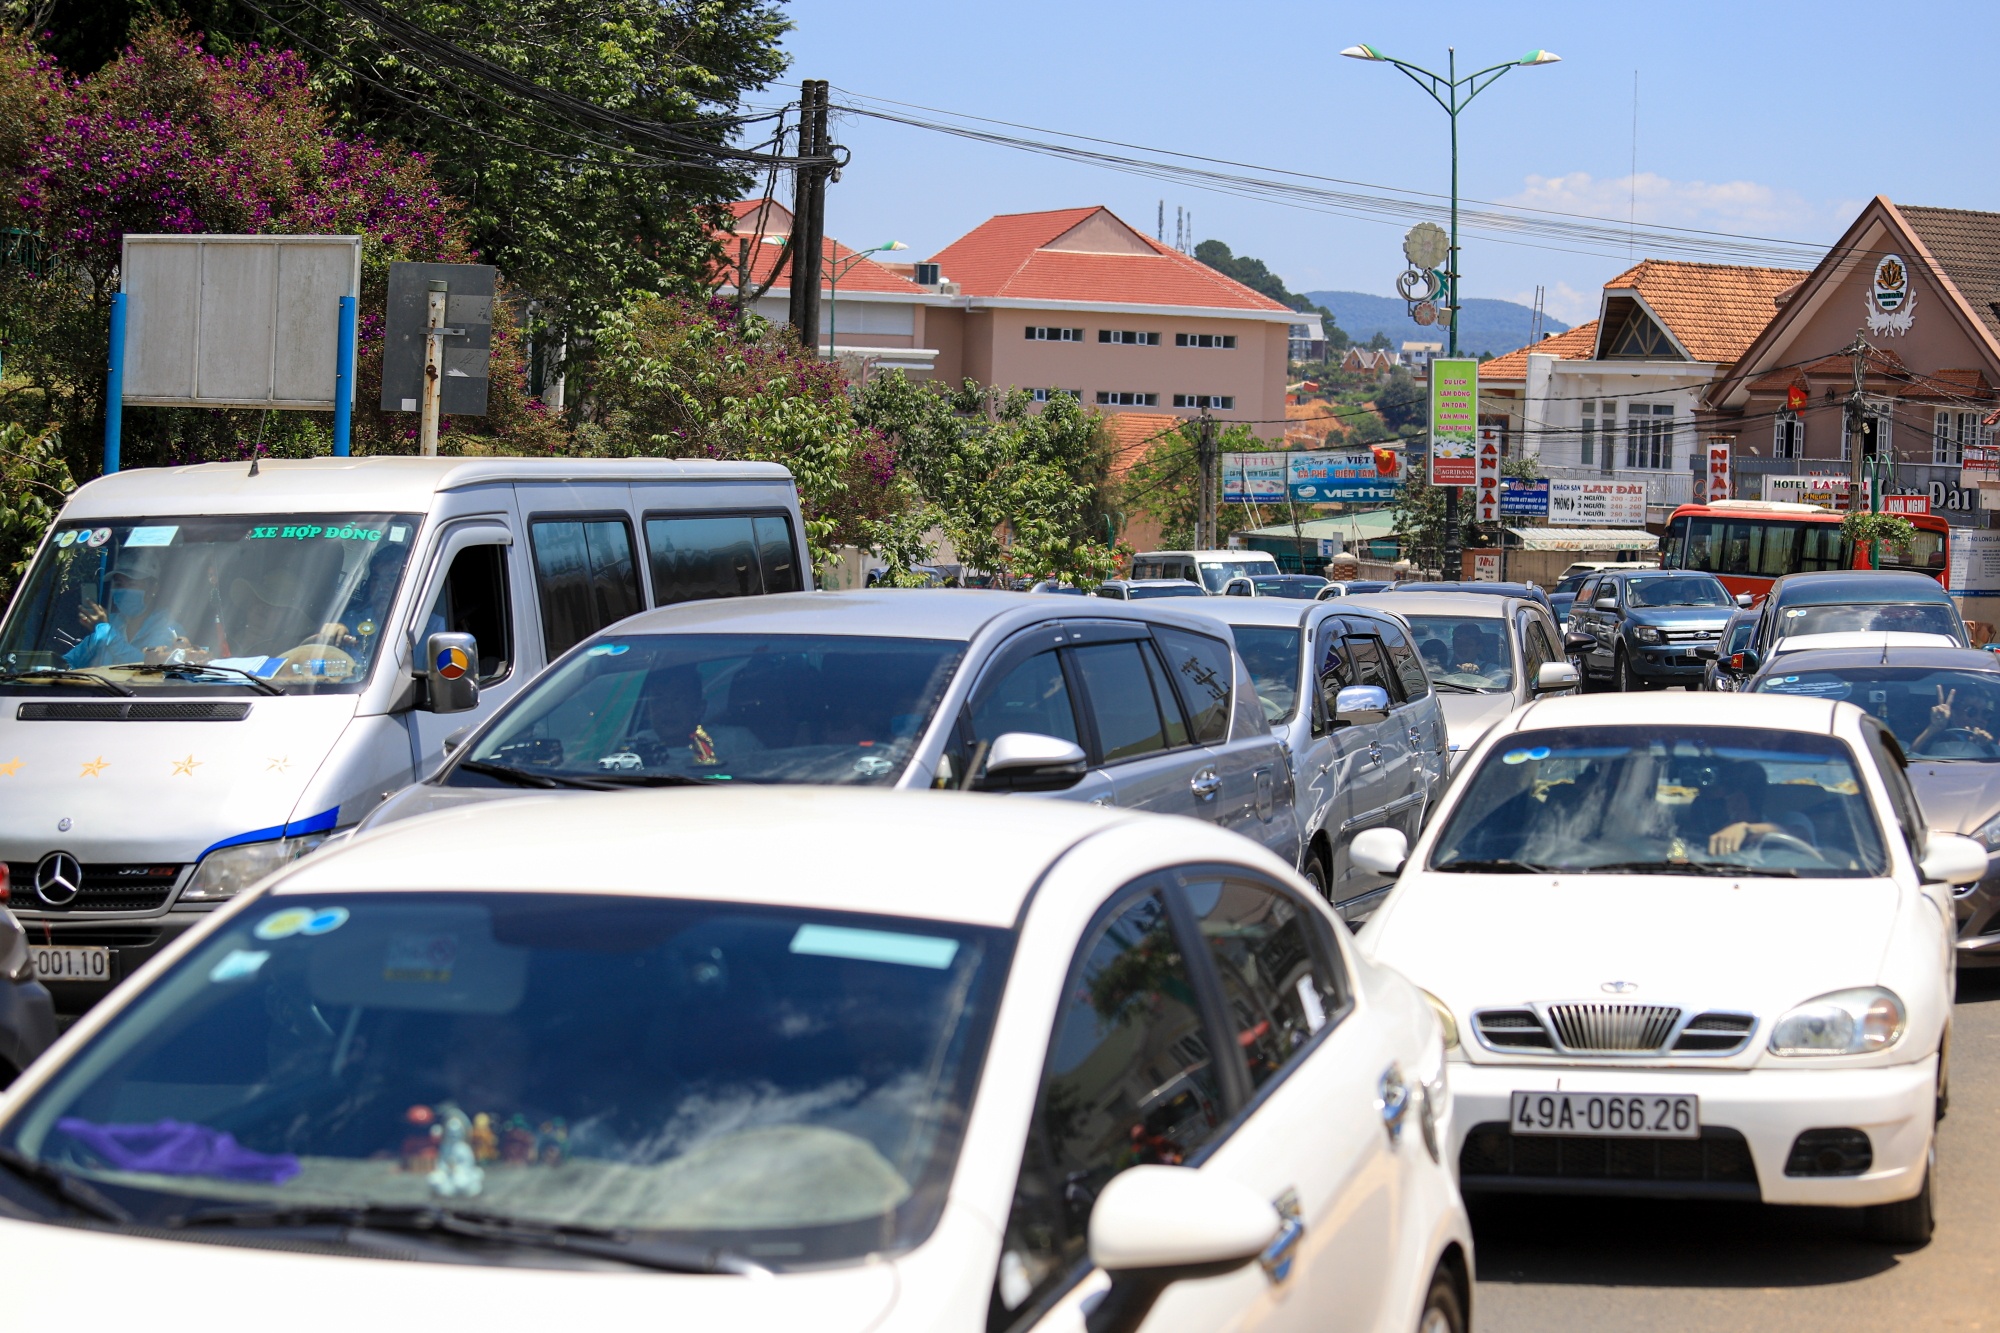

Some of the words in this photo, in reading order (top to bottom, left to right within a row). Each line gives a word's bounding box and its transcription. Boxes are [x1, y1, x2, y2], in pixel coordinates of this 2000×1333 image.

[1481, 429, 1498, 470] LAN
[1234, 456, 1259, 467] VỆT
[1347, 454, 1370, 466] VIỆT
[1553, 483, 1570, 491] KHÁCH
[1571, 484, 1581, 492] SẠN
[1583, 484, 1613, 494] LAN
[1616, 484, 1642, 494] ĐÀI
[1774, 480, 1808, 489] HOTEL
[1479, 477, 1497, 519] ĐÀI
[1554, 494, 1570, 510] PHÒNG
[1928, 481, 1971, 510] Đài
[1889, 498, 1904, 513] NHÀ
[1907, 496, 1926, 513] NGHỈ
[252, 527, 278, 539] XE
[281, 525, 322, 540] HỢP
[325, 522, 382, 541] ĐỒNG
[1518, 1095, 1690, 1131] 49A-066.26
